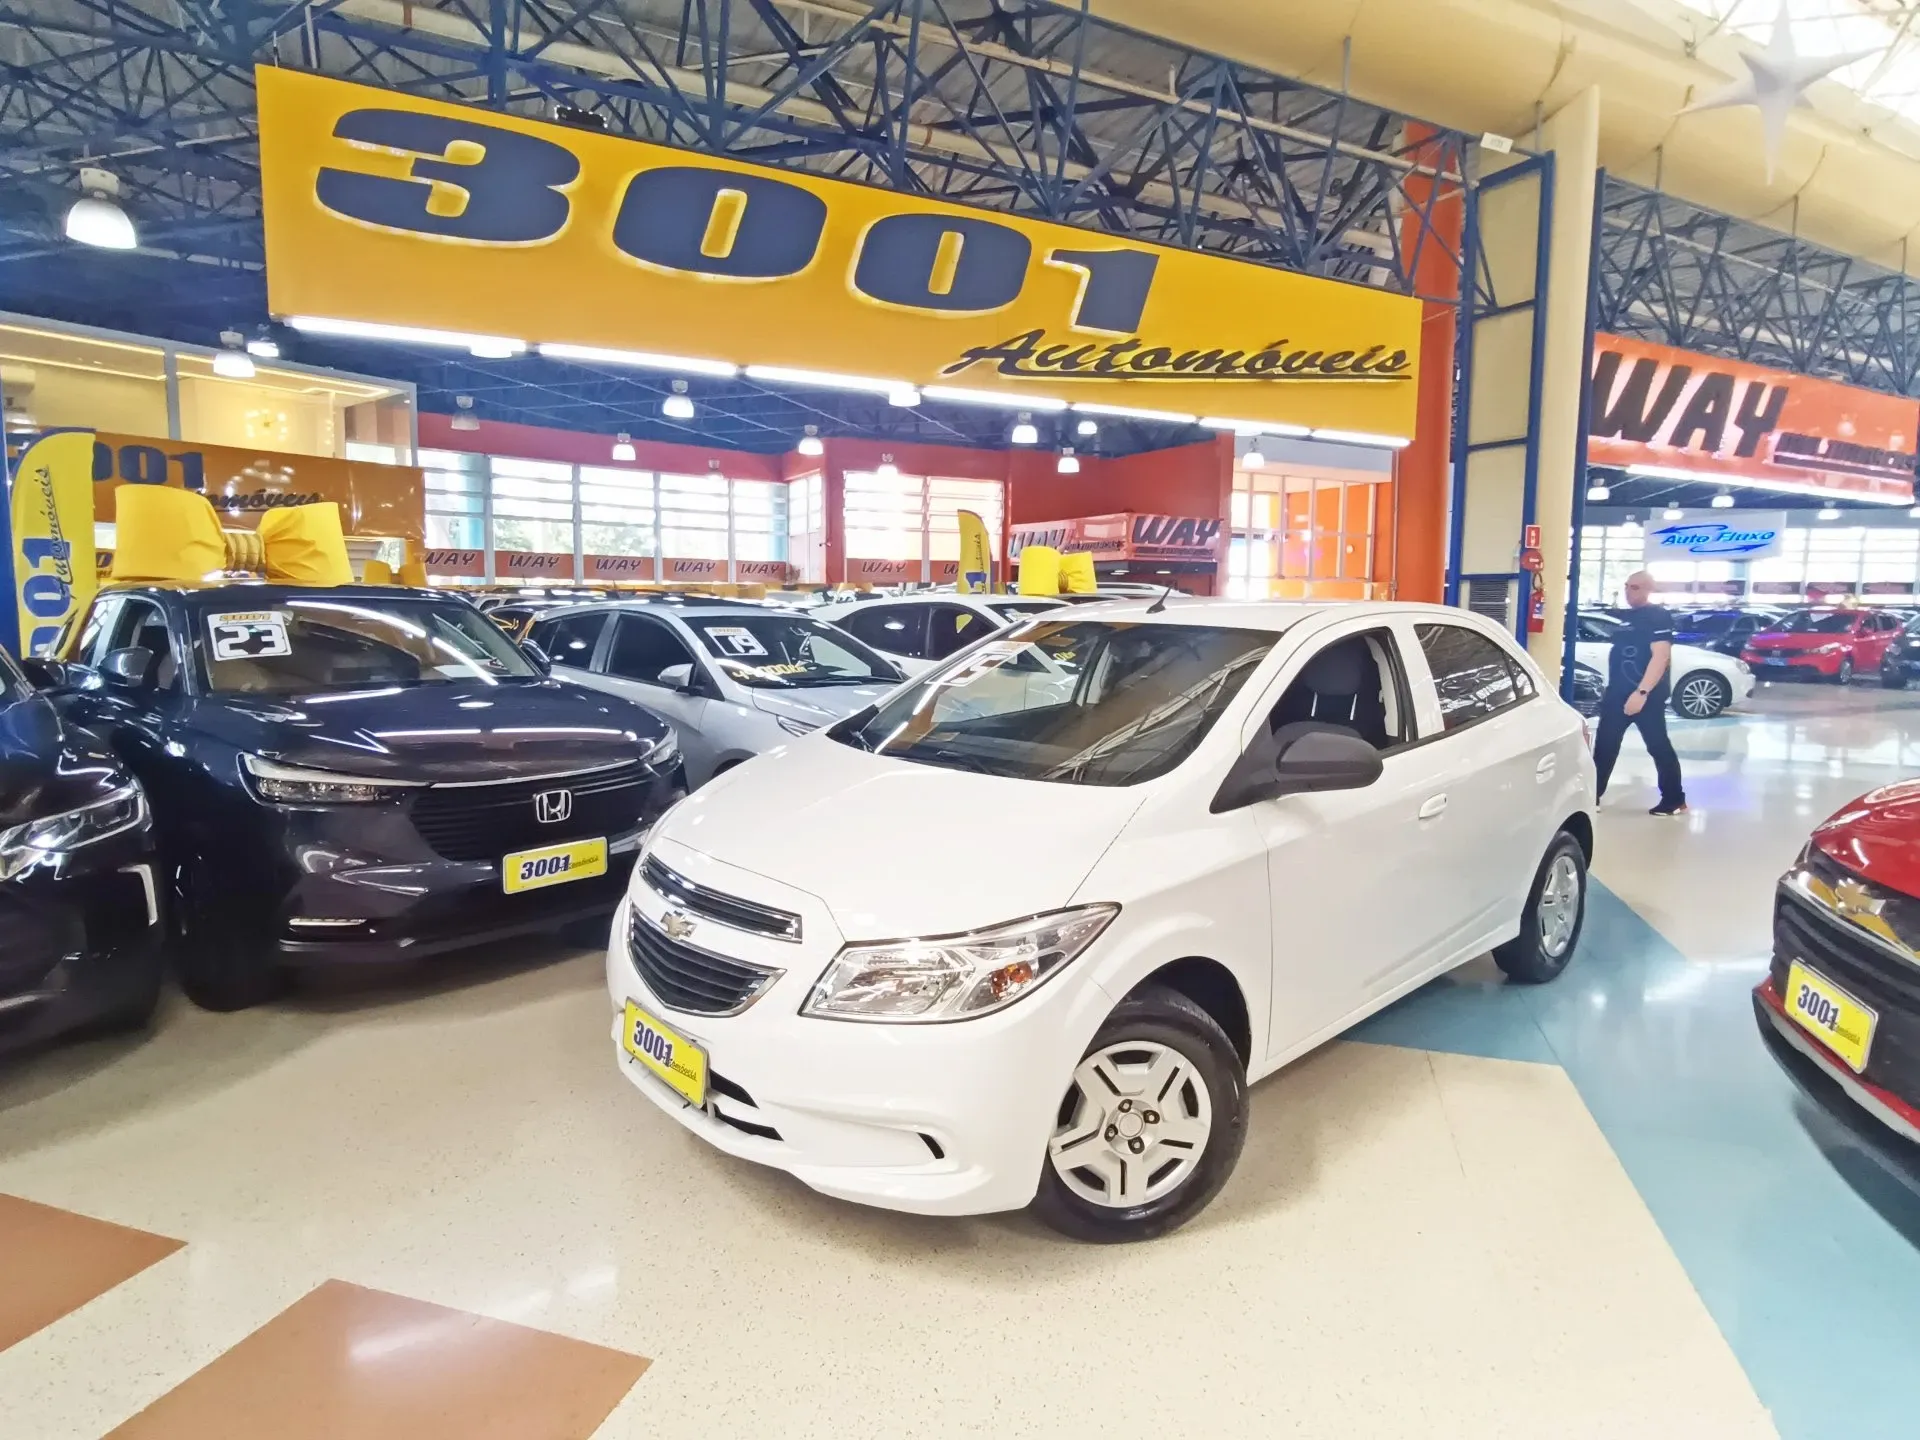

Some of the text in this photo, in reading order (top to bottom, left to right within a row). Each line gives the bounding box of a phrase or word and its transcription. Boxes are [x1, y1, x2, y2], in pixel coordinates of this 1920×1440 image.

[315, 108, 1158, 334] 3001
[942, 328, 1412, 380] Automóveis
[1589, 351, 1789, 458] WAY
[1132, 516, 1221, 546] WAY
[1661, 531, 1775, 545] Auto Fluxo
[509, 554, 561, 568] WAY
[596, 558, 642, 571] WAY
[674, 560, 716, 573] WAY
[740, 563, 781, 575] WAY
[862, 561, 907, 573] WAY
[217, 623, 288, 657] 23
[727, 635, 766, 655] 19
[520, 855, 571, 880] 3001
[1797, 984, 1839, 1031] 3001
[633, 1020, 673, 1067] 3001
